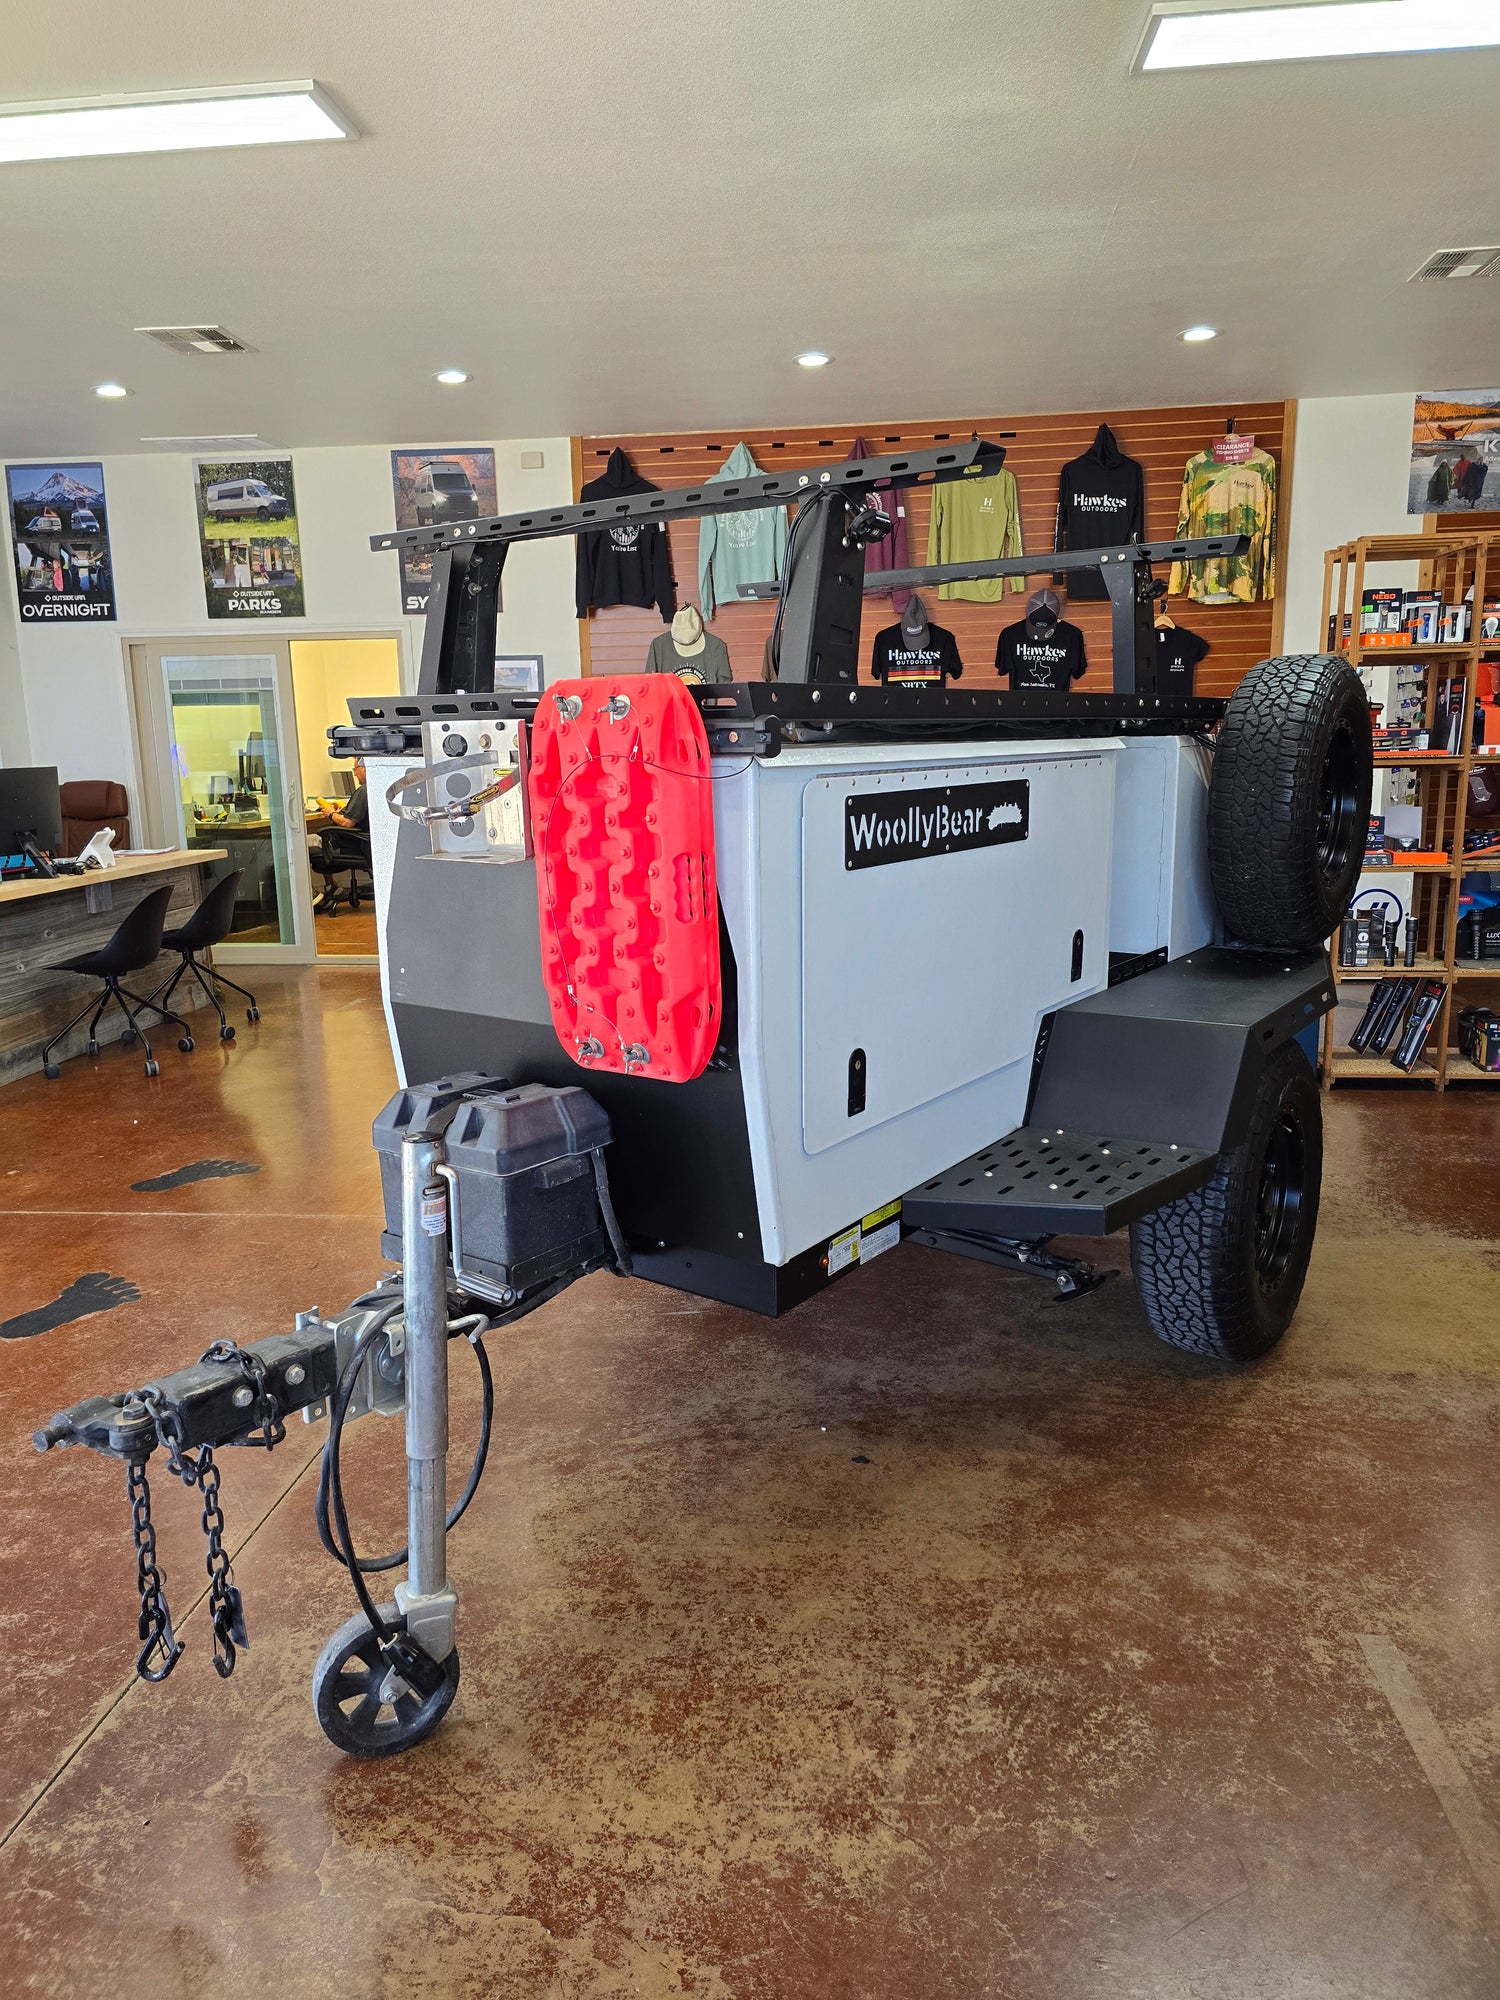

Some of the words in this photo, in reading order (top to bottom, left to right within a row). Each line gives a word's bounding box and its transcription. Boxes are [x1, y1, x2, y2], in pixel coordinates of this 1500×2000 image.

[1216, 442, 1250, 451] CLEARANCE
[1073, 493, 1127, 508] Hawkes
[227, 598, 282, 611] PARKS
[406, 595, 430, 609] SY
[22, 603, 111, 617] OVERNIGHT
[888, 649, 941, 661] Hawkes
[1016, 643, 1067, 658] Hawkes
[849, 803, 983, 852] WoollyBear
